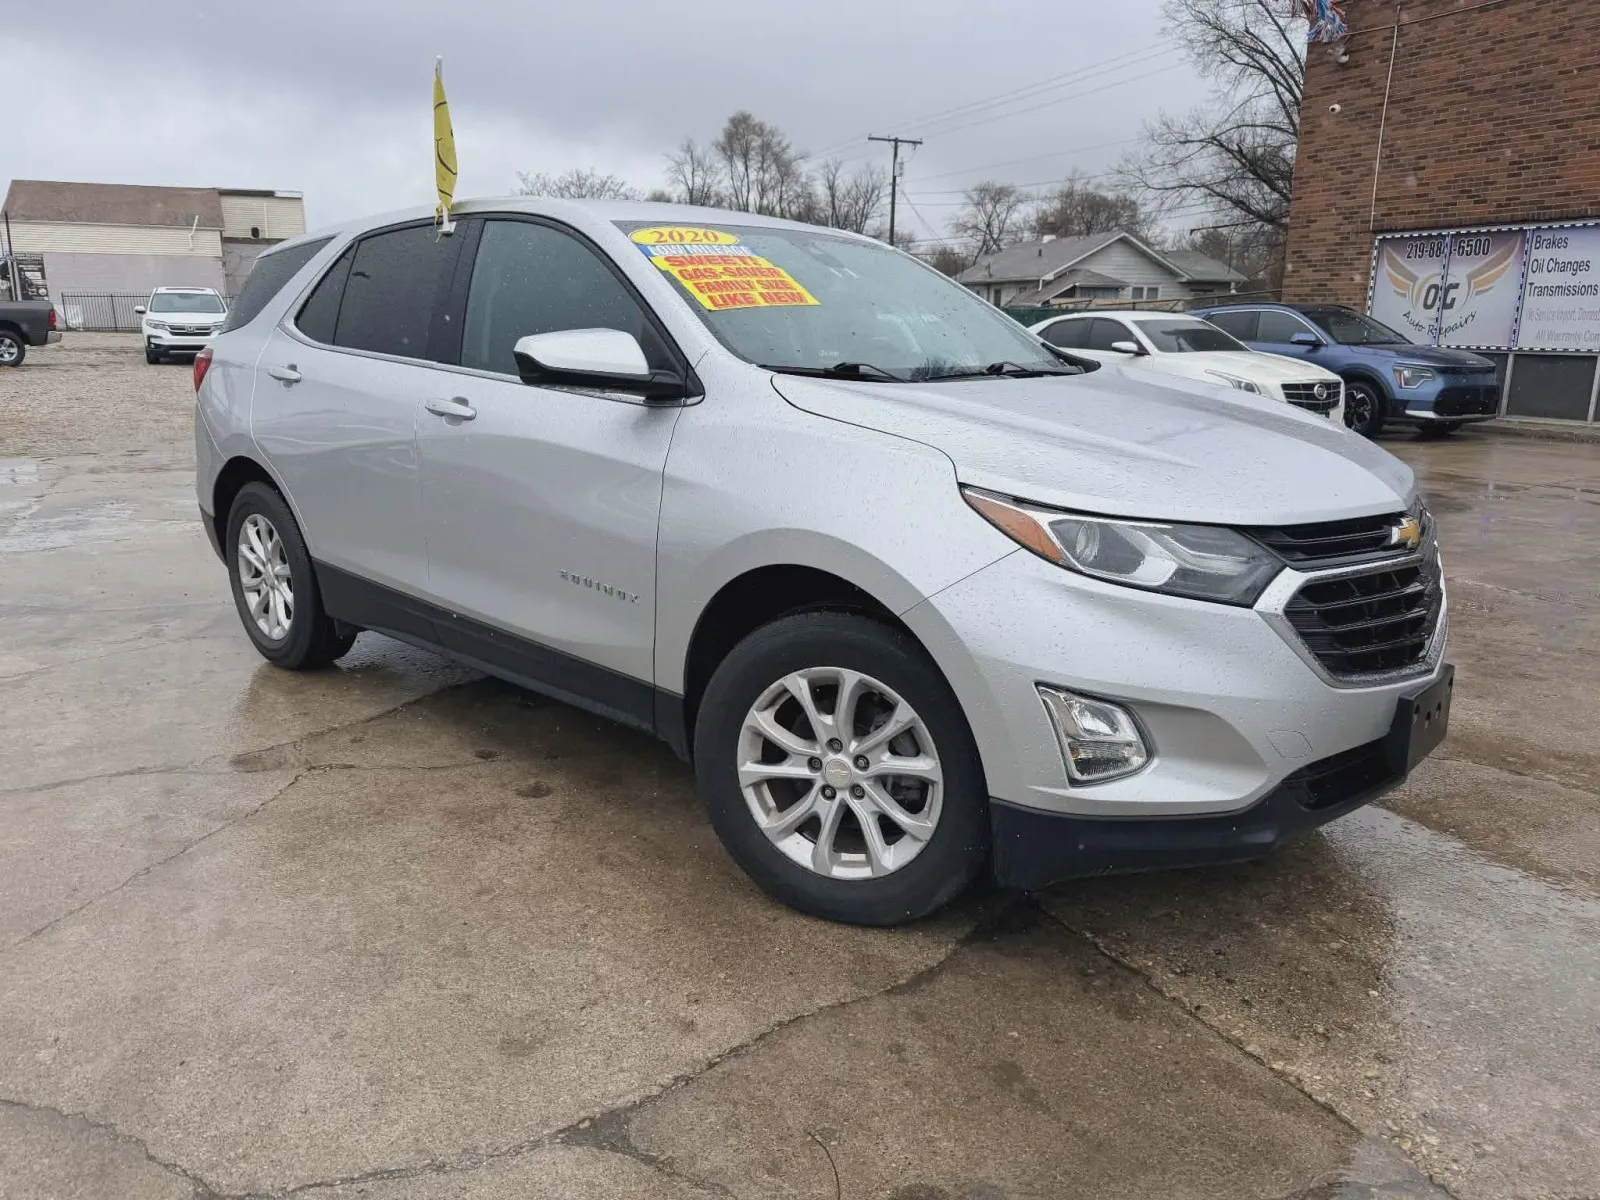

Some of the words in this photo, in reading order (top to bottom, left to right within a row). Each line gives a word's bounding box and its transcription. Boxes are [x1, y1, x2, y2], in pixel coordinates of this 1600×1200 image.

[650, 230, 720, 243] 2020
[1534, 233, 1569, 250] Brakes
[647, 244, 688, 256] LOW
[684, 244, 753, 256] MILEAGE
[1531, 257, 1545, 274] Oil
[1546, 257, 1591, 276] Changes
[692, 280, 758, 294] FAMILY
[756, 279, 798, 291] SIZE
[1528, 281, 1599, 297] Transmissions
[707, 292, 761, 308] LIKE
[1423, 283, 1460, 310] OG
[1402, 310, 1426, 332] Auto
[1547, 328, 1583, 345] Warranty
[558, 568, 640, 604] EQUINOX
